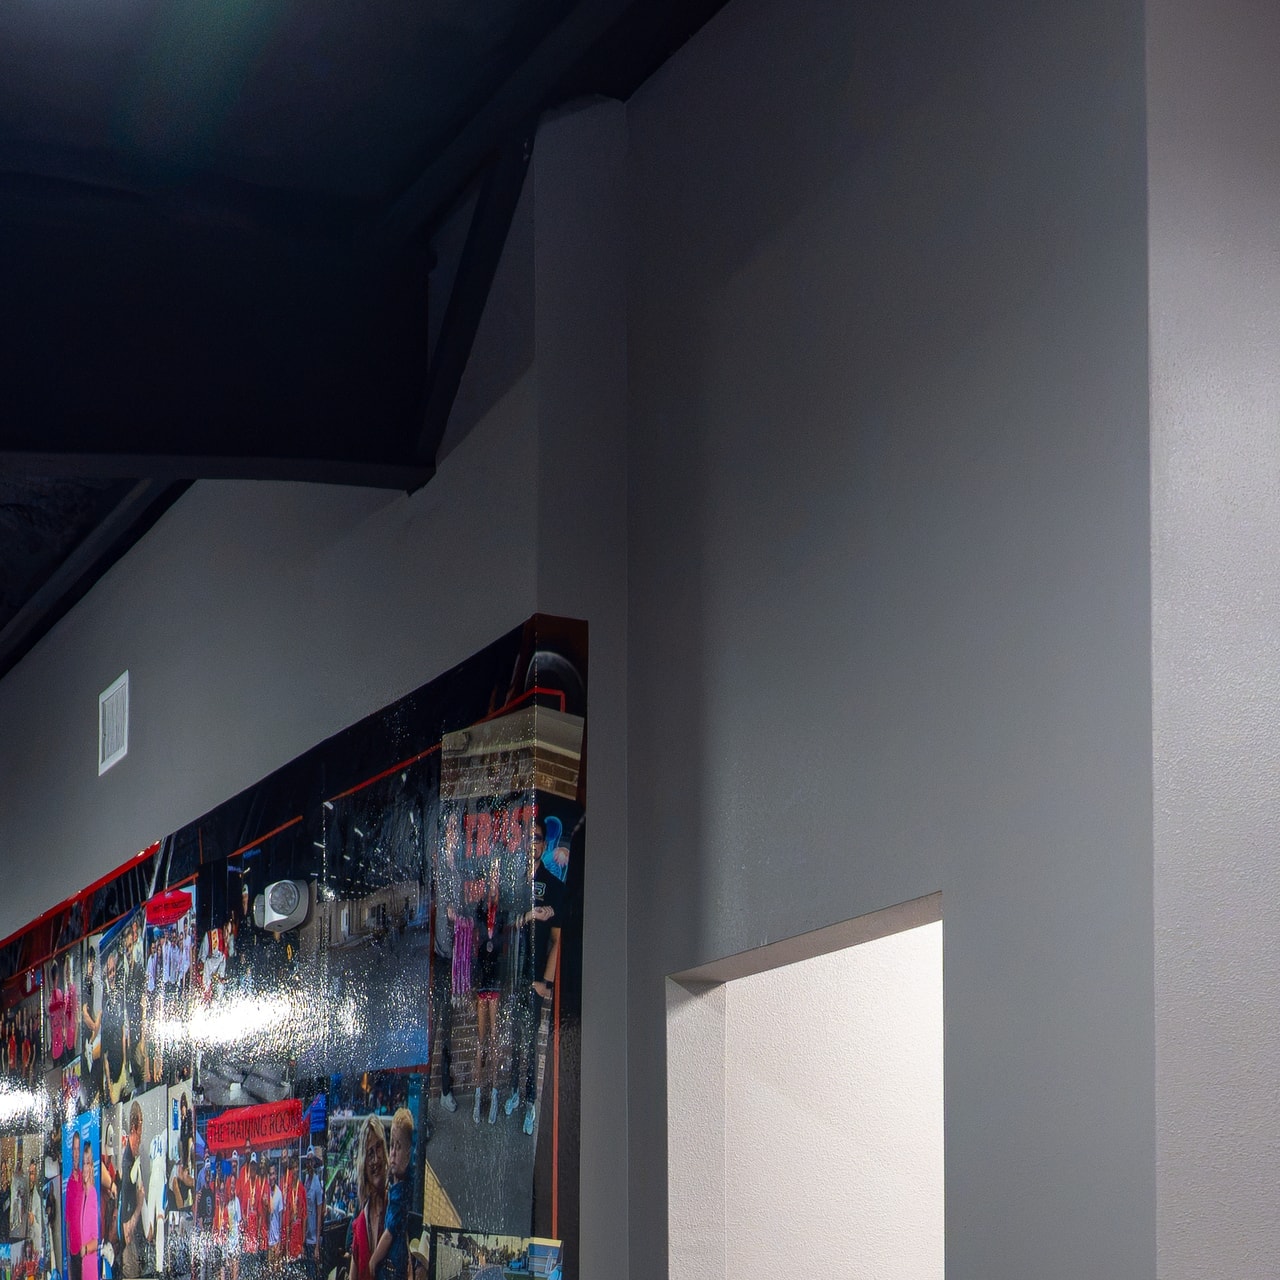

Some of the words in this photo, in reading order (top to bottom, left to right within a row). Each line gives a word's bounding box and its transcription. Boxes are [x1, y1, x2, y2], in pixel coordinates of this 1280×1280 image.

[209, 1123, 224, 1143] THE
[225, 1115, 267, 1141] TRAINING
[269, 1109, 300, 1135] ROOM
